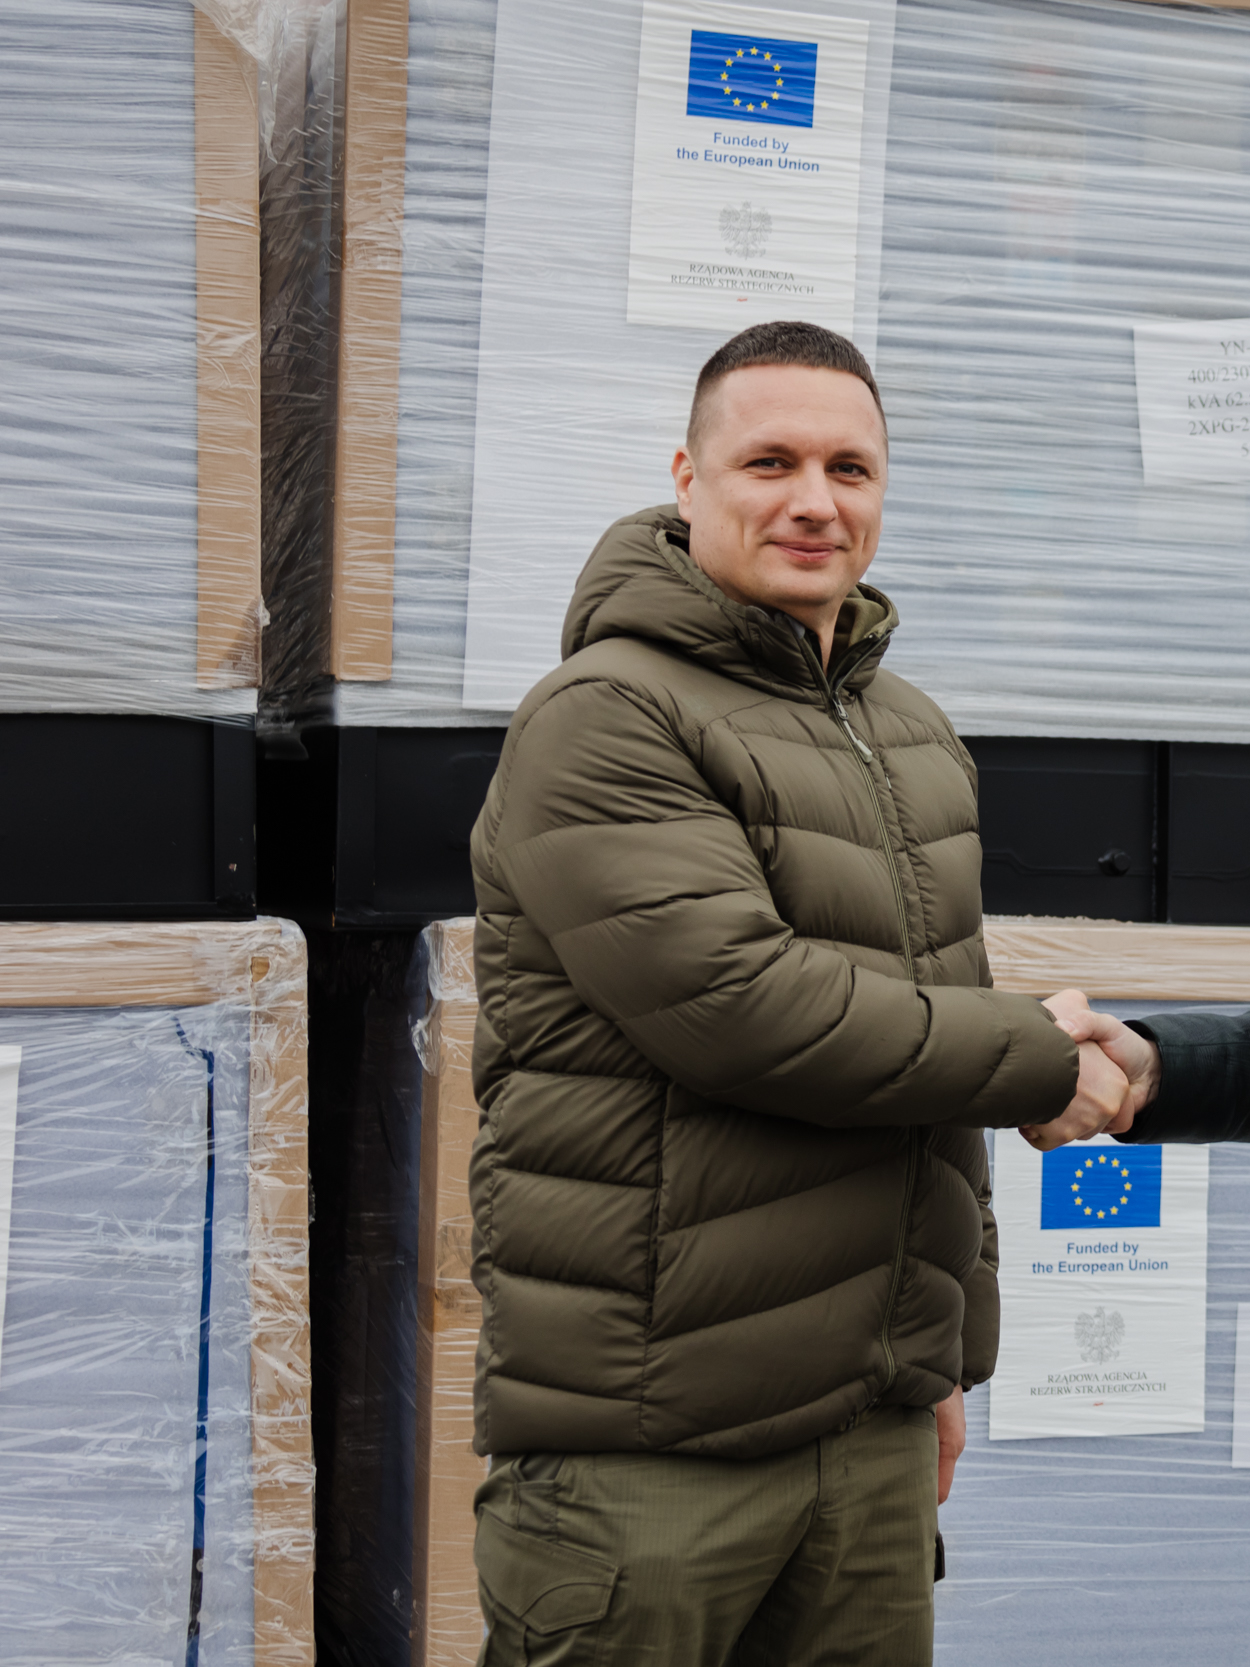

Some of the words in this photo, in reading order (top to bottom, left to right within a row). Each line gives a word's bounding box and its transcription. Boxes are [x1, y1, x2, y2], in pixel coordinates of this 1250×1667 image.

[714, 132, 767, 149] Funded
[772, 137, 789, 153] by
[676, 147, 699, 160] the
[704, 150, 773, 168] European
[778, 157, 819, 172] Union
[747, 269, 795, 281] AGENCJA
[671, 275, 715, 287] REZERW
[718, 278, 814, 294] STRATEGICZNYCH
[1188, 394, 1221, 409] kVA
[1067, 1242, 1118, 1254] Funded
[1123, 1242, 1139, 1256] by
[1032, 1262, 1053, 1273] the
[1058, 1260, 1124, 1274] European
[1129, 1259, 1168, 1271] Union
[1101, 1372, 1147, 1381] AGENCJA
[1030, 1386, 1072, 1396] REZERW
[1075, 1383, 1166, 1394] STRATEGICZNYCH
